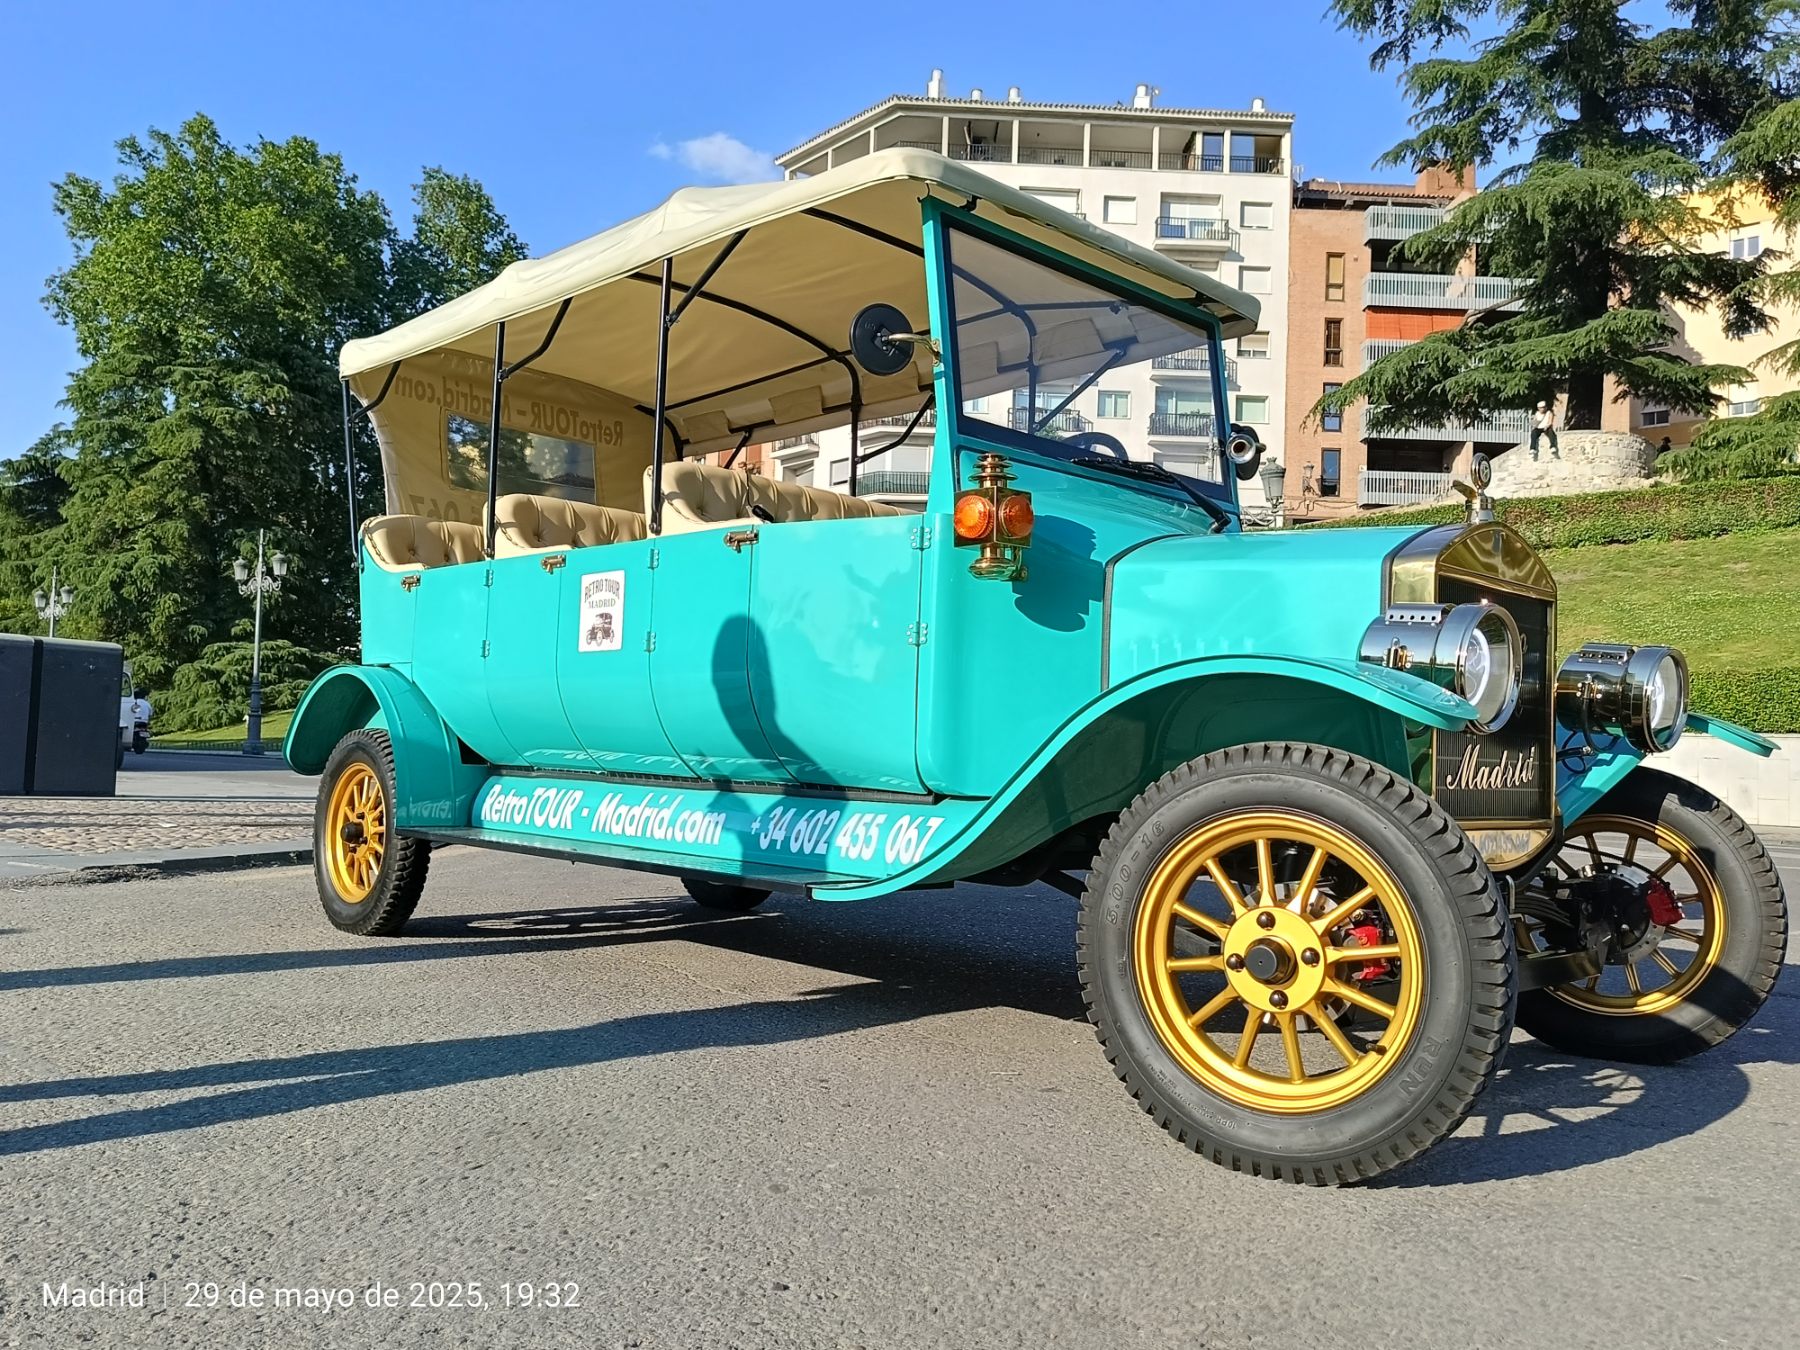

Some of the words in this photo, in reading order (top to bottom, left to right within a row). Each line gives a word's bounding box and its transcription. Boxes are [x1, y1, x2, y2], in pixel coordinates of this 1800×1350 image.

[584, 578, 604, 604] RETRO
[604, 578, 621, 601] TOUR
[588, 598, 617, 609] MADRID
[1446, 743, 1536, 790] Madrid
[481, 784, 584, 830] RetroTOUR
[591, 792, 726, 846] Madrid.com
[789, 809, 841, 855] 602
[834, 813, 888, 861] 455
[884, 815, 945, 865] 067
